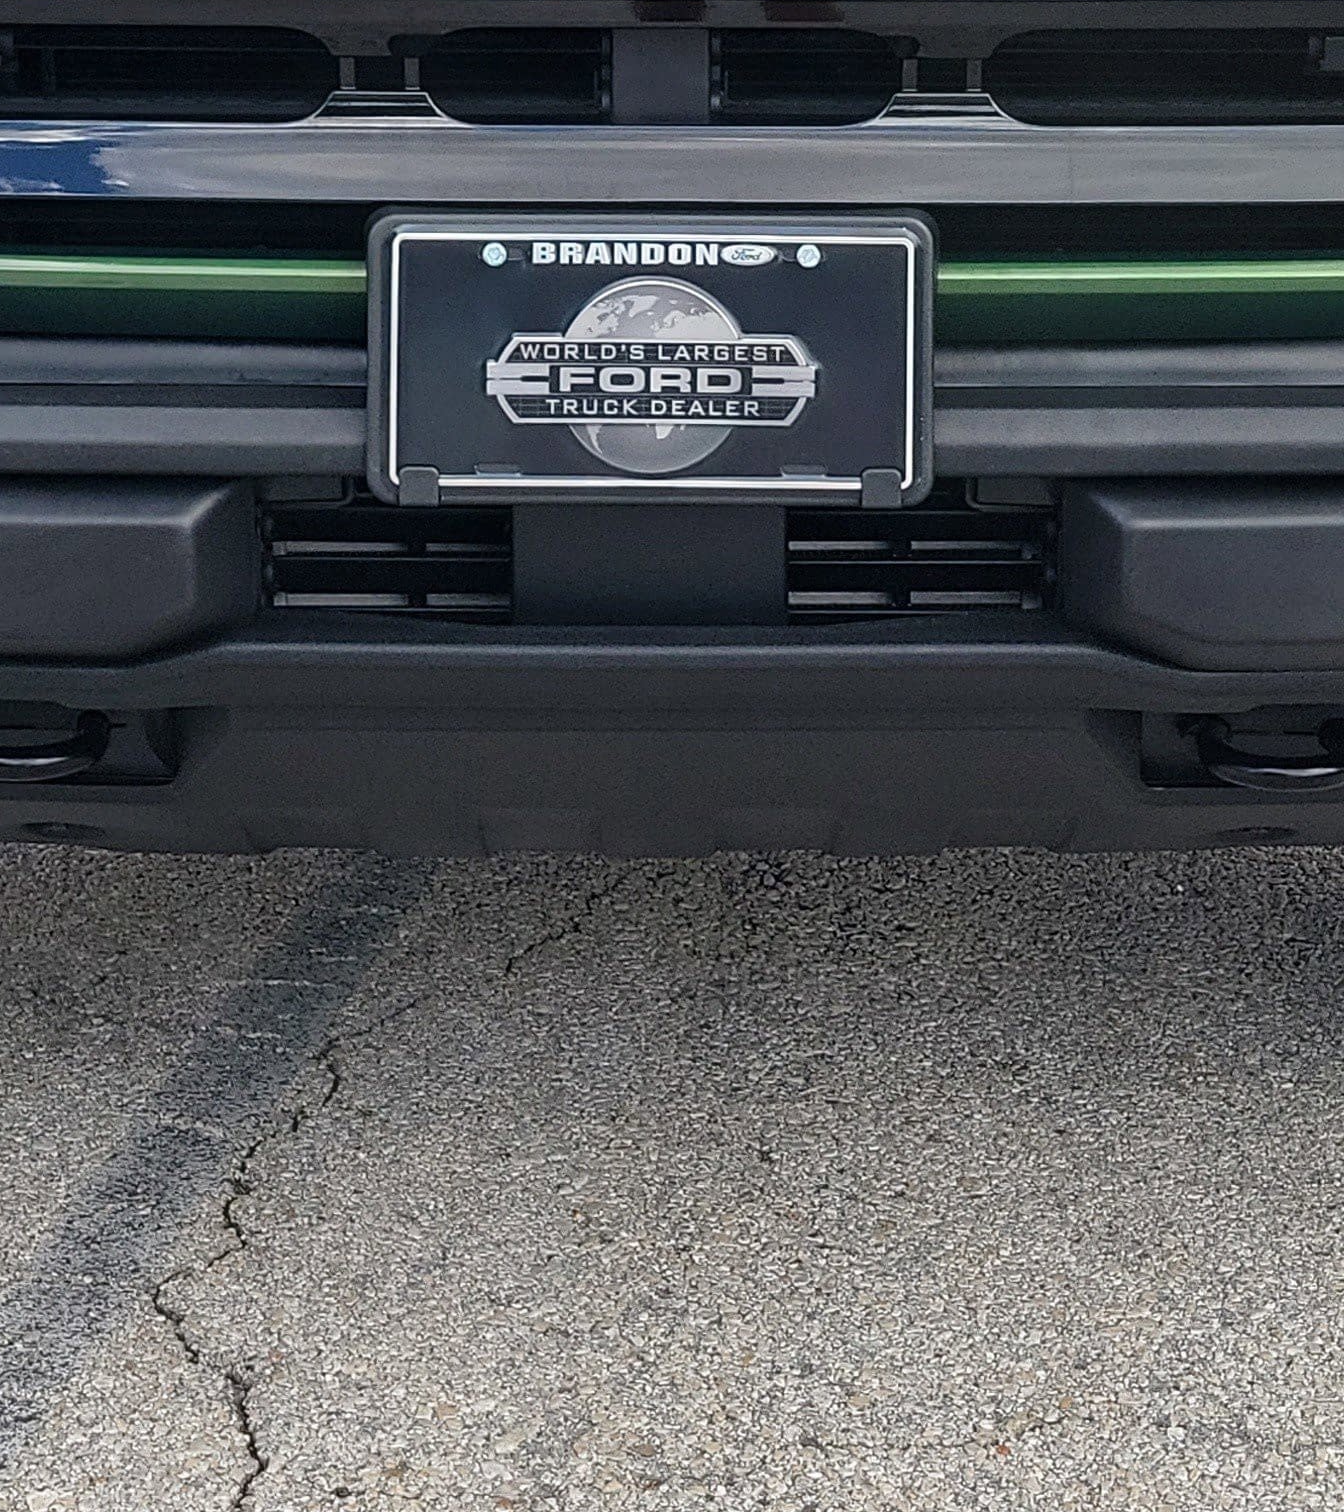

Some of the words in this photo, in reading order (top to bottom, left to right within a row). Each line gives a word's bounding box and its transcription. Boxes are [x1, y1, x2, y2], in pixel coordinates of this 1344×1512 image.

[531, 242, 719, 265] BRANDON
[519, 343, 645, 361] WORLD'S
[657, 344, 786, 363] LARGEST
[558, 366, 743, 394] FORD
[545, 398, 639, 416] TRUCK
[650, 399, 761, 417] DEALER
